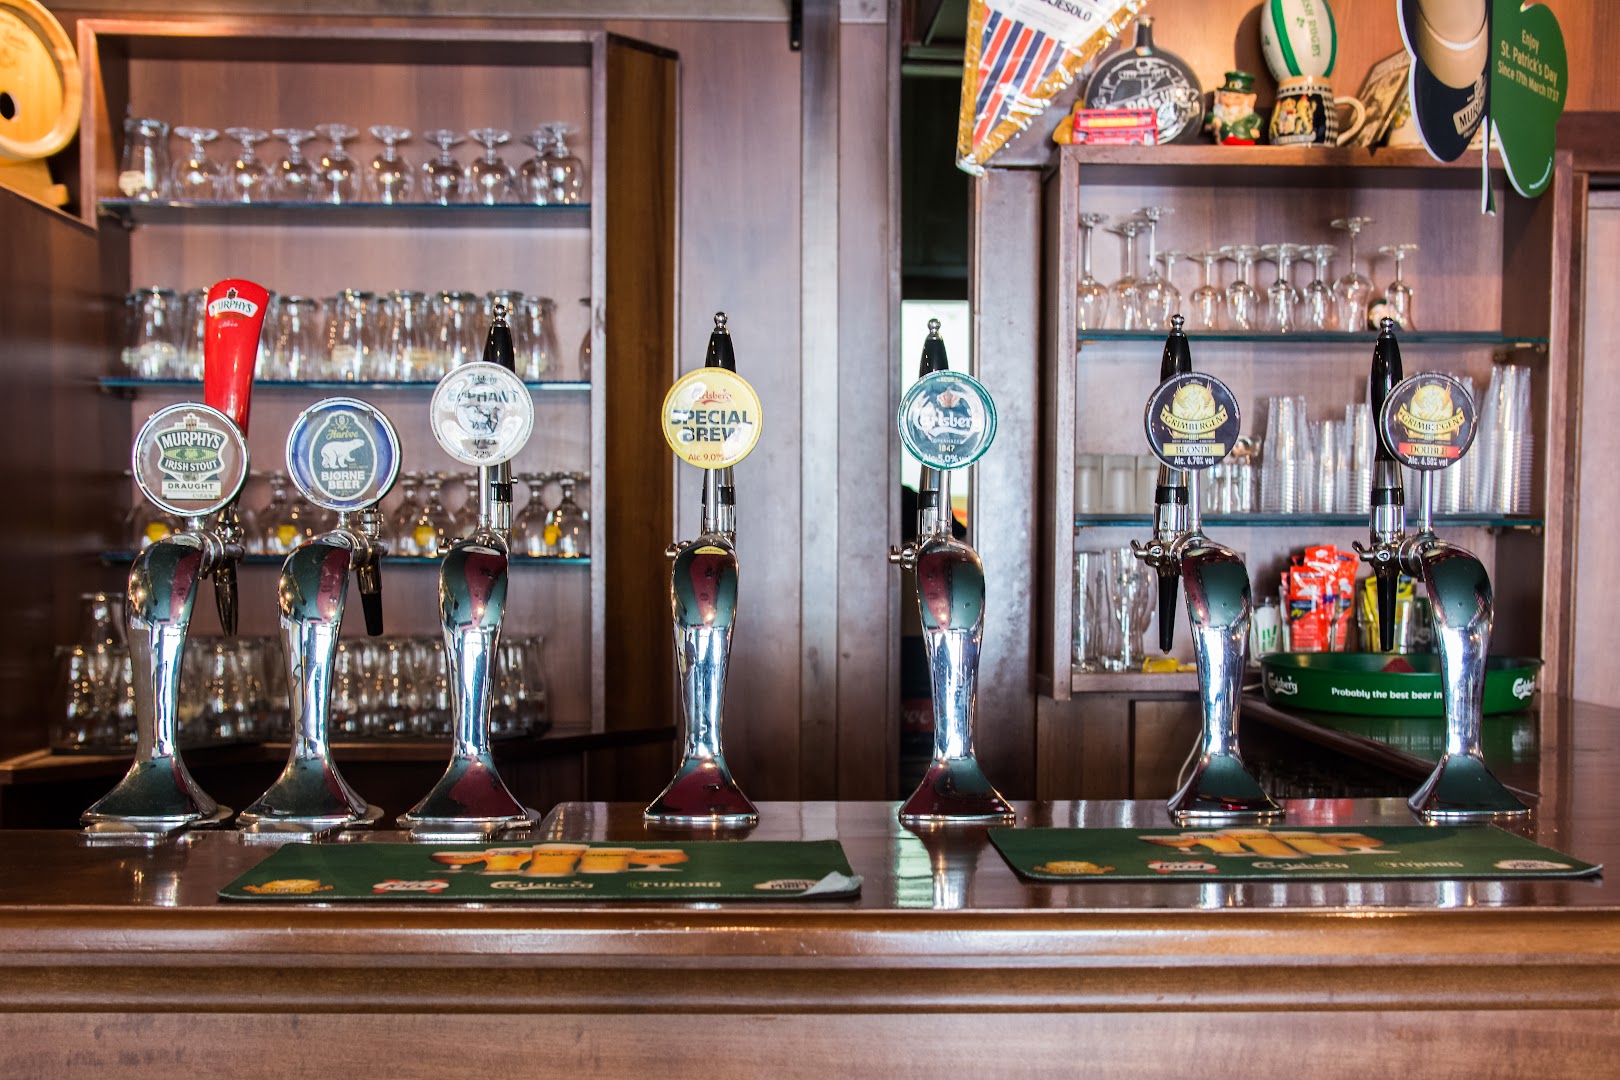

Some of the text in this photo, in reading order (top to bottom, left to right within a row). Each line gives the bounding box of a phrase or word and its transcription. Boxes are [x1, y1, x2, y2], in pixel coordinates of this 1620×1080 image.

[1522, 29, 1539, 54] Enjoy
[1501, 40, 1557, 88] St. Patrick's Day
[1498, 60, 1514, 80] Since
[1516, 70, 1527, 87] 17th
[1528, 77, 1546, 96] March
[671, 409, 752, 425] SPECIAL
[1165, 416, 1222, 430] GRIMBERGEN
[682, 427, 738, 442] BREW
[1176, 446, 1212, 454] BLONDE
[1411, 446, 1448, 455] DOUBLE
[164, 459, 217, 472] IRISH STOUT
[1174, 456, 1185, 465] Alc.
[1204, 456, 1214, 465] vol
[1408, 456, 1420, 465] Alc.
[1438, 458, 1448, 467] vol
[321, 470, 365, 481] BJØRNE
[168, 482, 214, 490] DRAUGHT
[328, 480, 360, 490] BEER
[1331, 687, 1443, 700] Probably the best beer in
[640, 880, 721, 889] TUBORG
